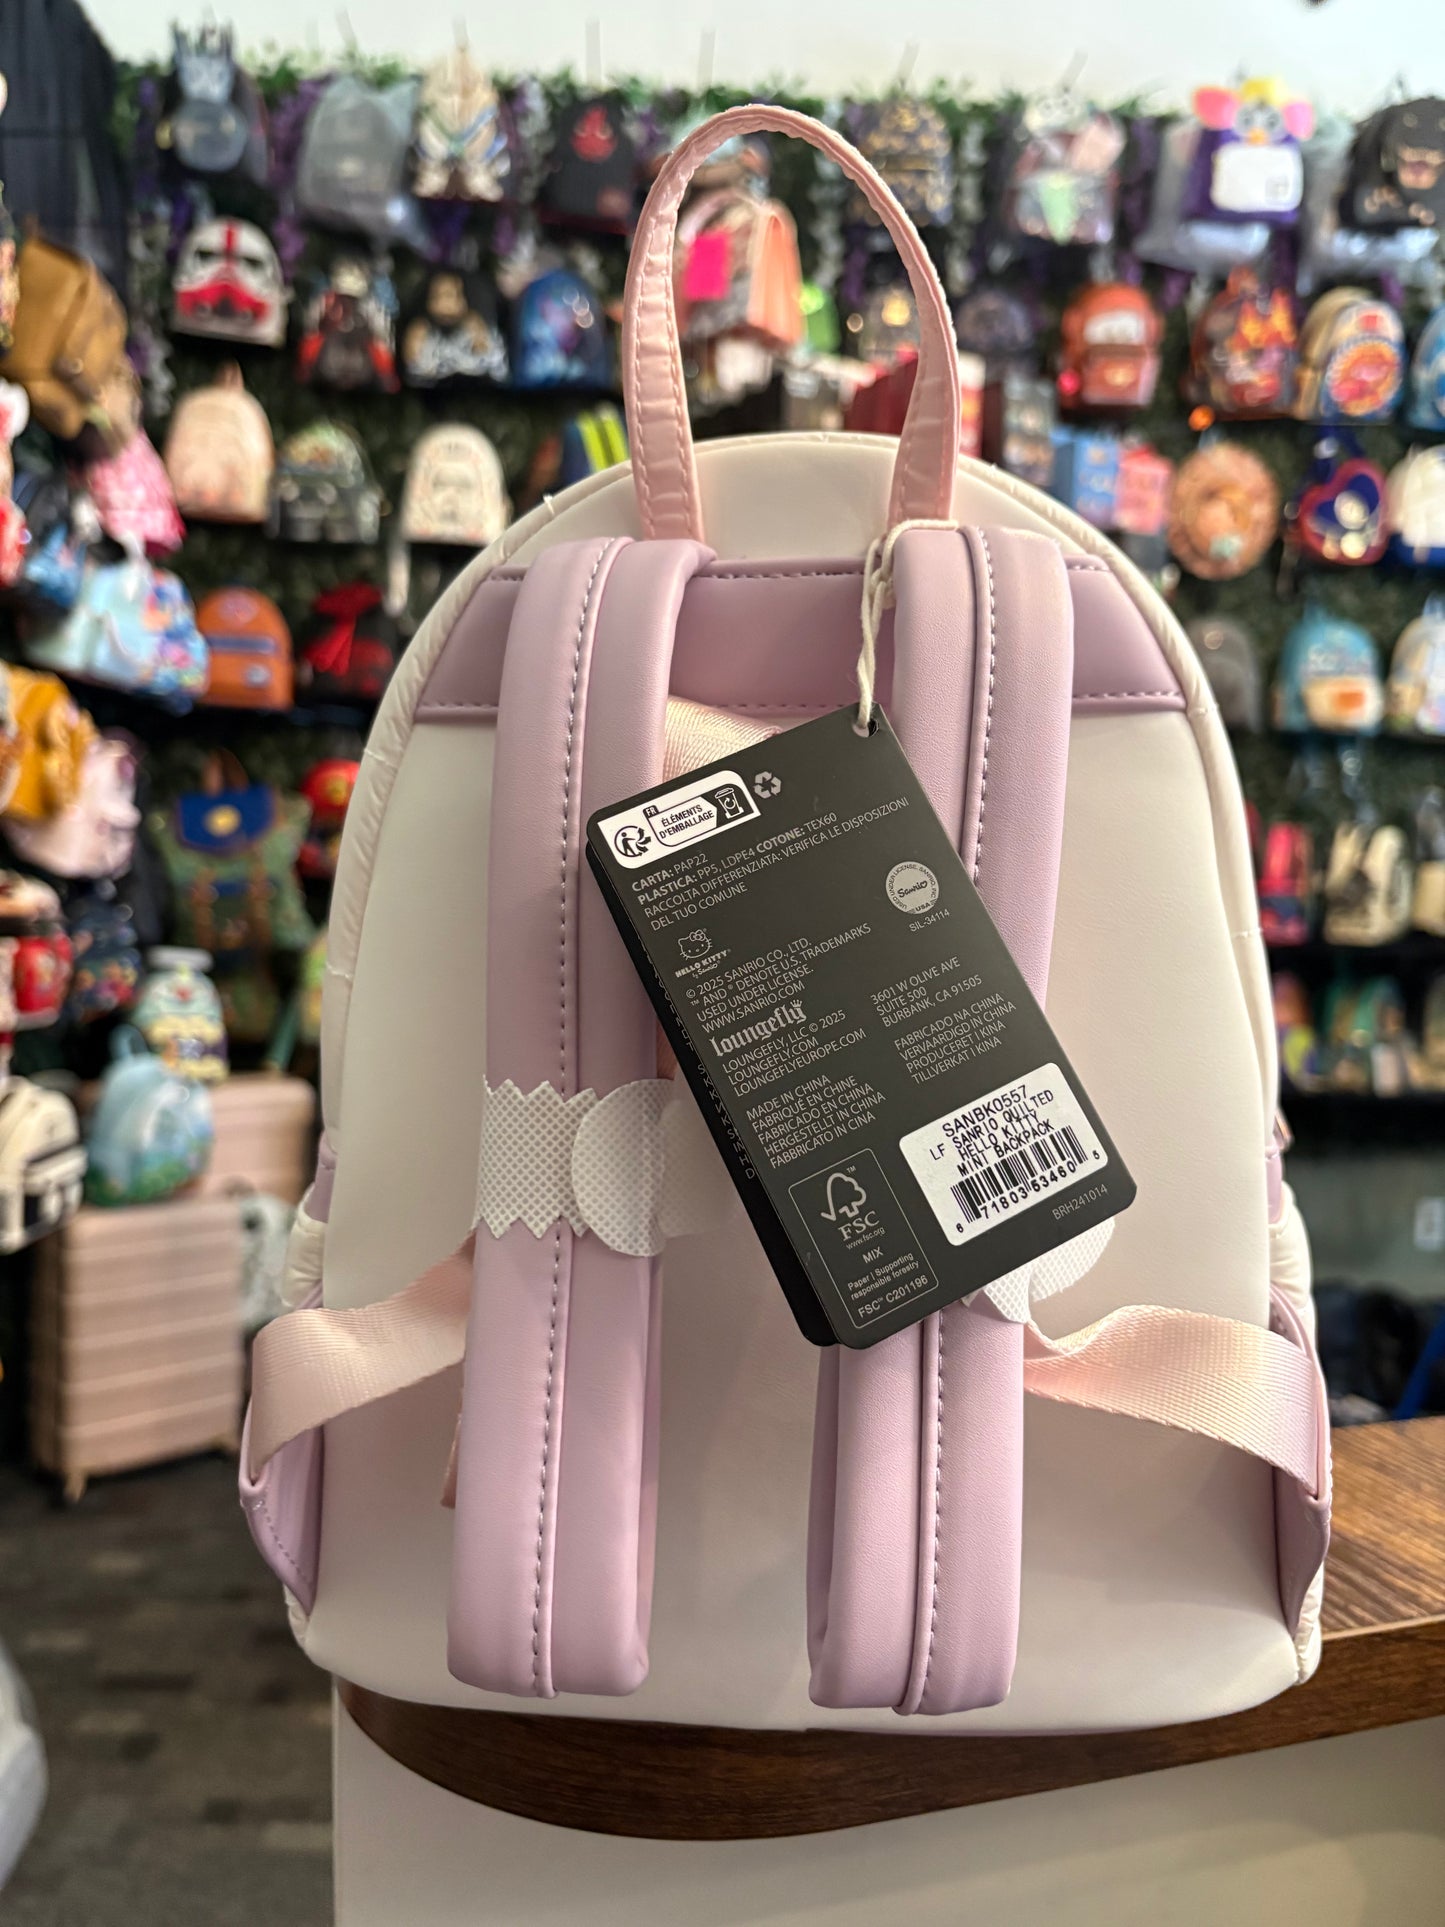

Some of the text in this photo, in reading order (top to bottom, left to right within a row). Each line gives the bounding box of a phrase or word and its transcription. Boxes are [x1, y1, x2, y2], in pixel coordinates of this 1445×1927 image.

[646, 807, 656, 816] FR
[659, 810, 714, 839] D'EMBALLAGE
[661, 805, 702, 827] ÉLÉMENTS
[632, 854, 708, 891] CARTA: PAP22
[638, 813, 837, 905] PLASTICA: PP5, LDPE4 COTONE: TEX60
[644, 797, 909, 918] RACCOLTA DIFFERENZIATA: VERIFICA LE DISPOSIZIONI
[651, 882, 747, 930] DEL TUO COMUNE
[897, 881, 927, 898] Sanrio
[915, 903, 930, 911] USA
[909, 909, 949, 931] SIL-34114
[675, 963, 701, 977] HELLO
[697, 976, 723, 994] 2025
[725, 957, 765, 982] SANRIO
[767, 949, 788, 962] CO.,
[788, 938, 811, 953] LTD.
[703, 989, 727, 1006] AND
[736, 964, 780, 991] DENOTE
[780, 956, 801, 970] U.S.
[800, 923, 871, 960] TRADEMARKS
[871, 957, 960, 1004] 3601 W OLIVE AVE
[697, 964, 813, 1021] USED UNDER LICENSE.
[702, 980, 805, 1033] WWW.SANRIO.COM
[877, 987, 926, 1016] SUITE 500
[882, 975, 982, 1027] BURBANK, CA 91505
[709, 1000, 806, 1056] loungefly
[723, 1037, 788, 1073] LOUNGEFLY,
[788, 1027, 808, 1043] LLC
[819, 1010, 845, 1028] 2025
[894, 993, 1004, 1050] FABRICADO NA CHINA
[900, 1002, 1016, 1060] VERVAARDIGD IN CHINA
[906, 1020, 1006, 1073] PRODUCERET I KINA
[728, 1037, 819, 1085] LOUNGEFLY.COM
[734, 1028, 866, 1096] LOUNGEFLYEUROPE.COM
[912, 1036, 1001, 1084] TILLVERKAT I KINA
[747, 1075, 831, 1120] MADE IN CHINA
[752, 1076, 857, 1132] FABRIQUÉ EN CHINE
[758, 1083, 873, 1144] FABRICADO EN CHINA
[942, 1085, 1026, 1137] SANBK0557
[764, 1092, 886, 1156] HERGESTELLT IN CHINA
[770, 1111, 875, 1168] FABBRICATO IN CINA
[930, 1090, 1053, 1160] LF SANRIO QUILTED
[957, 1119, 1054, 1176] MINI BACKPACK
[958, 1111, 1040, 1161] HELLO KITTY
[980, 1187, 1028, 1219] 71803
[1093, 1150, 1100, 1159] 5
[1052, 1184, 1107, 1220] BRH241014
[838, 1211, 879, 1241] FSC
[846, 1227, 885, 1249] www.fsc.org
[848, 1275, 869, 1290] Paper
[875, 1253, 913, 1276] Supporting
[863, 1247, 883, 1263] MIX
[851, 1261, 918, 1300] responsible forestry
[886, 1275, 928, 1302] C201196
